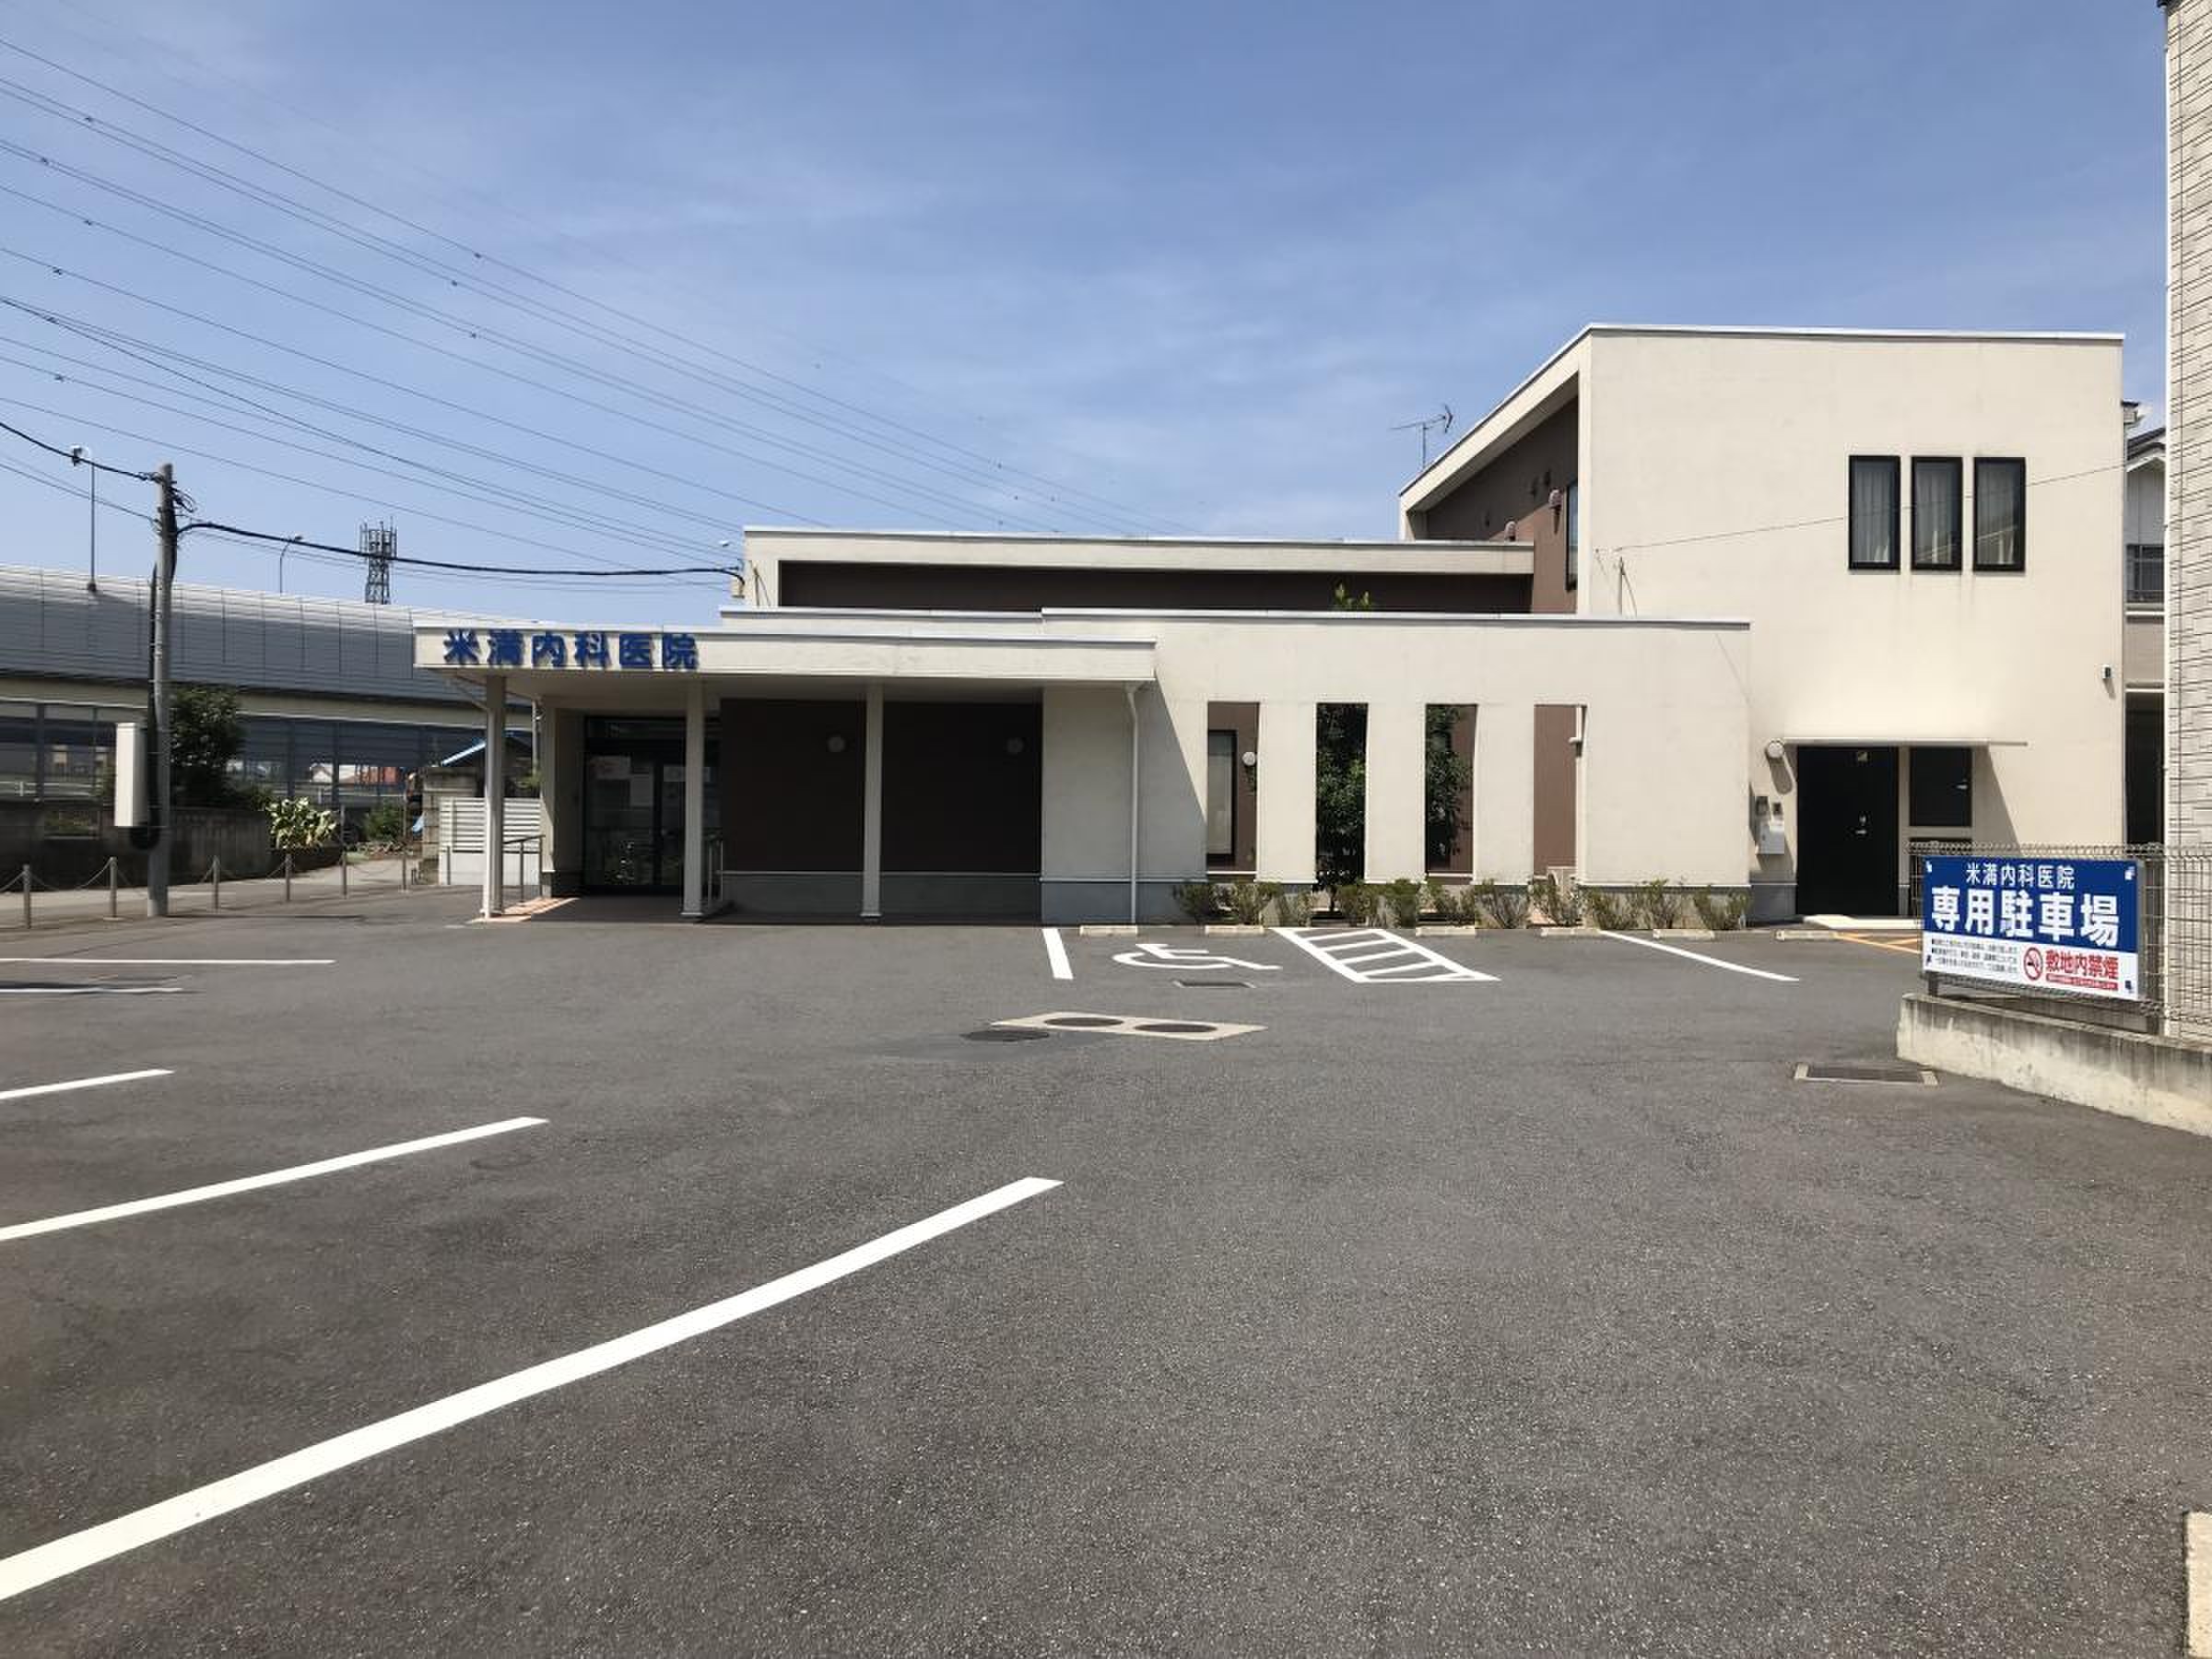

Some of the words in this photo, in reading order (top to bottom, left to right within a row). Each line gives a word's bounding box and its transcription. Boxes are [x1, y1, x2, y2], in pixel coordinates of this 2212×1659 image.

[1966, 862, 2075, 889] 米満内科医院
[1931, 885, 2119, 947] 専用駐車場
[2045, 949, 2119, 981] 敷地内禁煙
